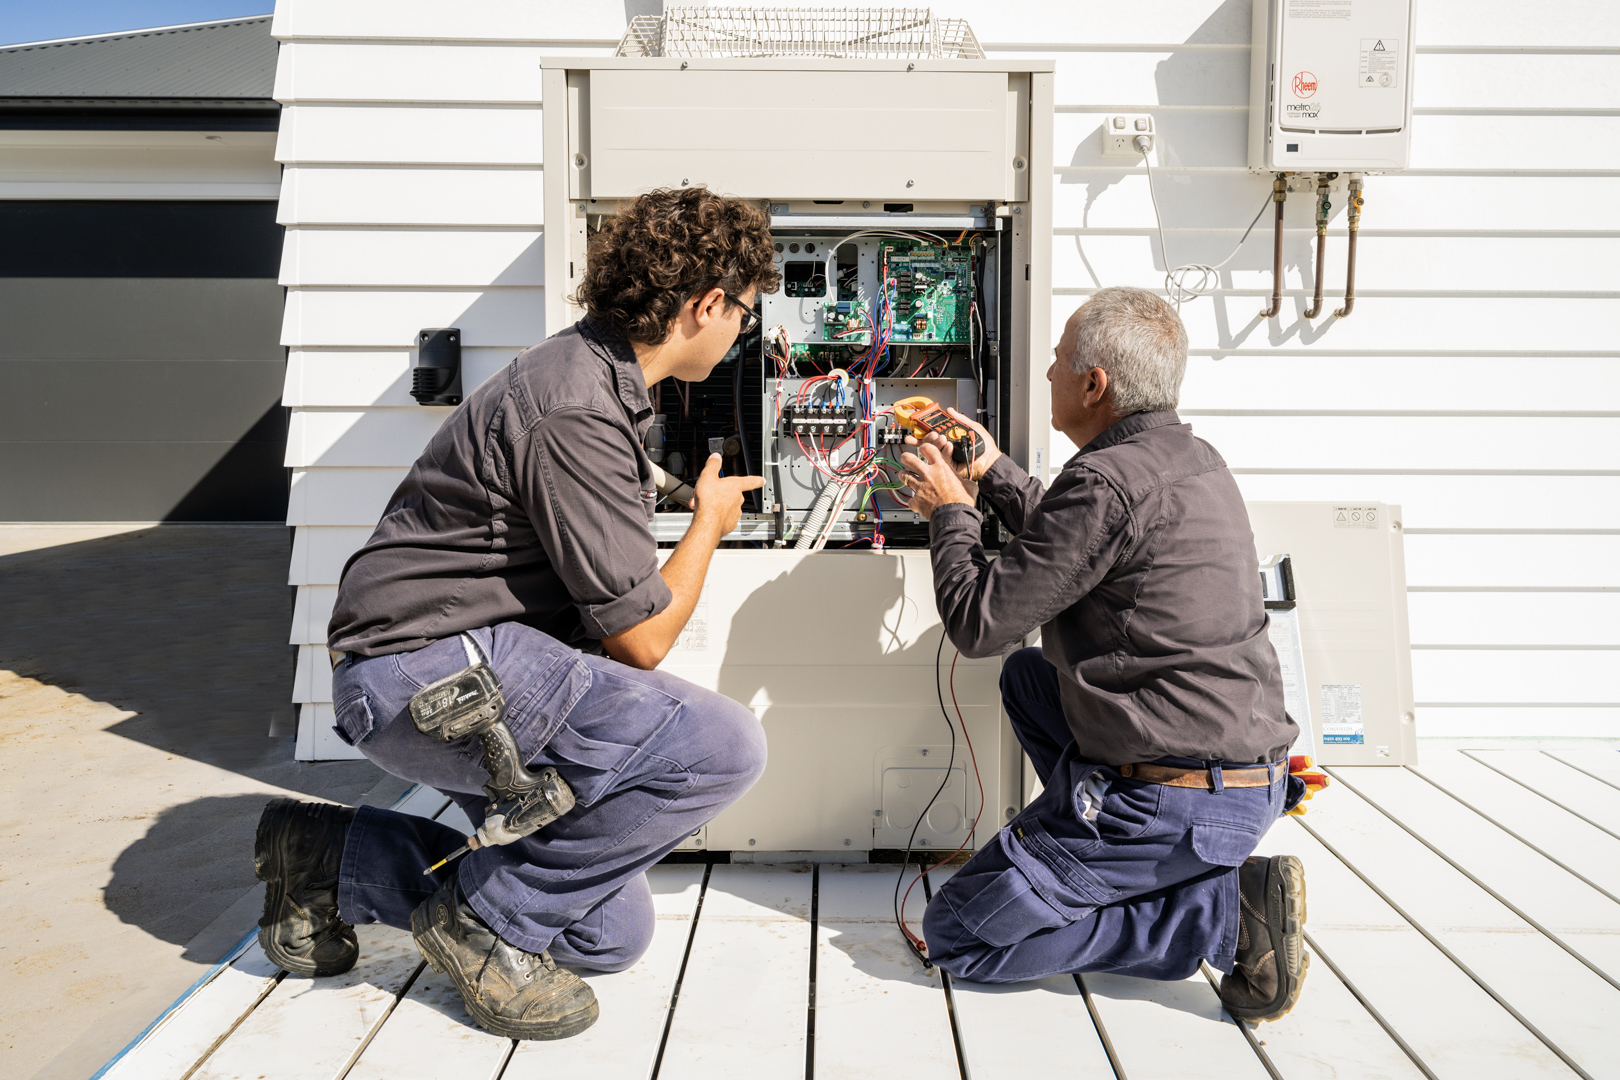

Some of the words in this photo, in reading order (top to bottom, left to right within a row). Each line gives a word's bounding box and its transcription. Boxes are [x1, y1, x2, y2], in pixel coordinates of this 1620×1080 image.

[1293, 71, 1318, 95] Rheem
[1286, 102, 1311, 111] metro
[1302, 110, 1320, 118] max
